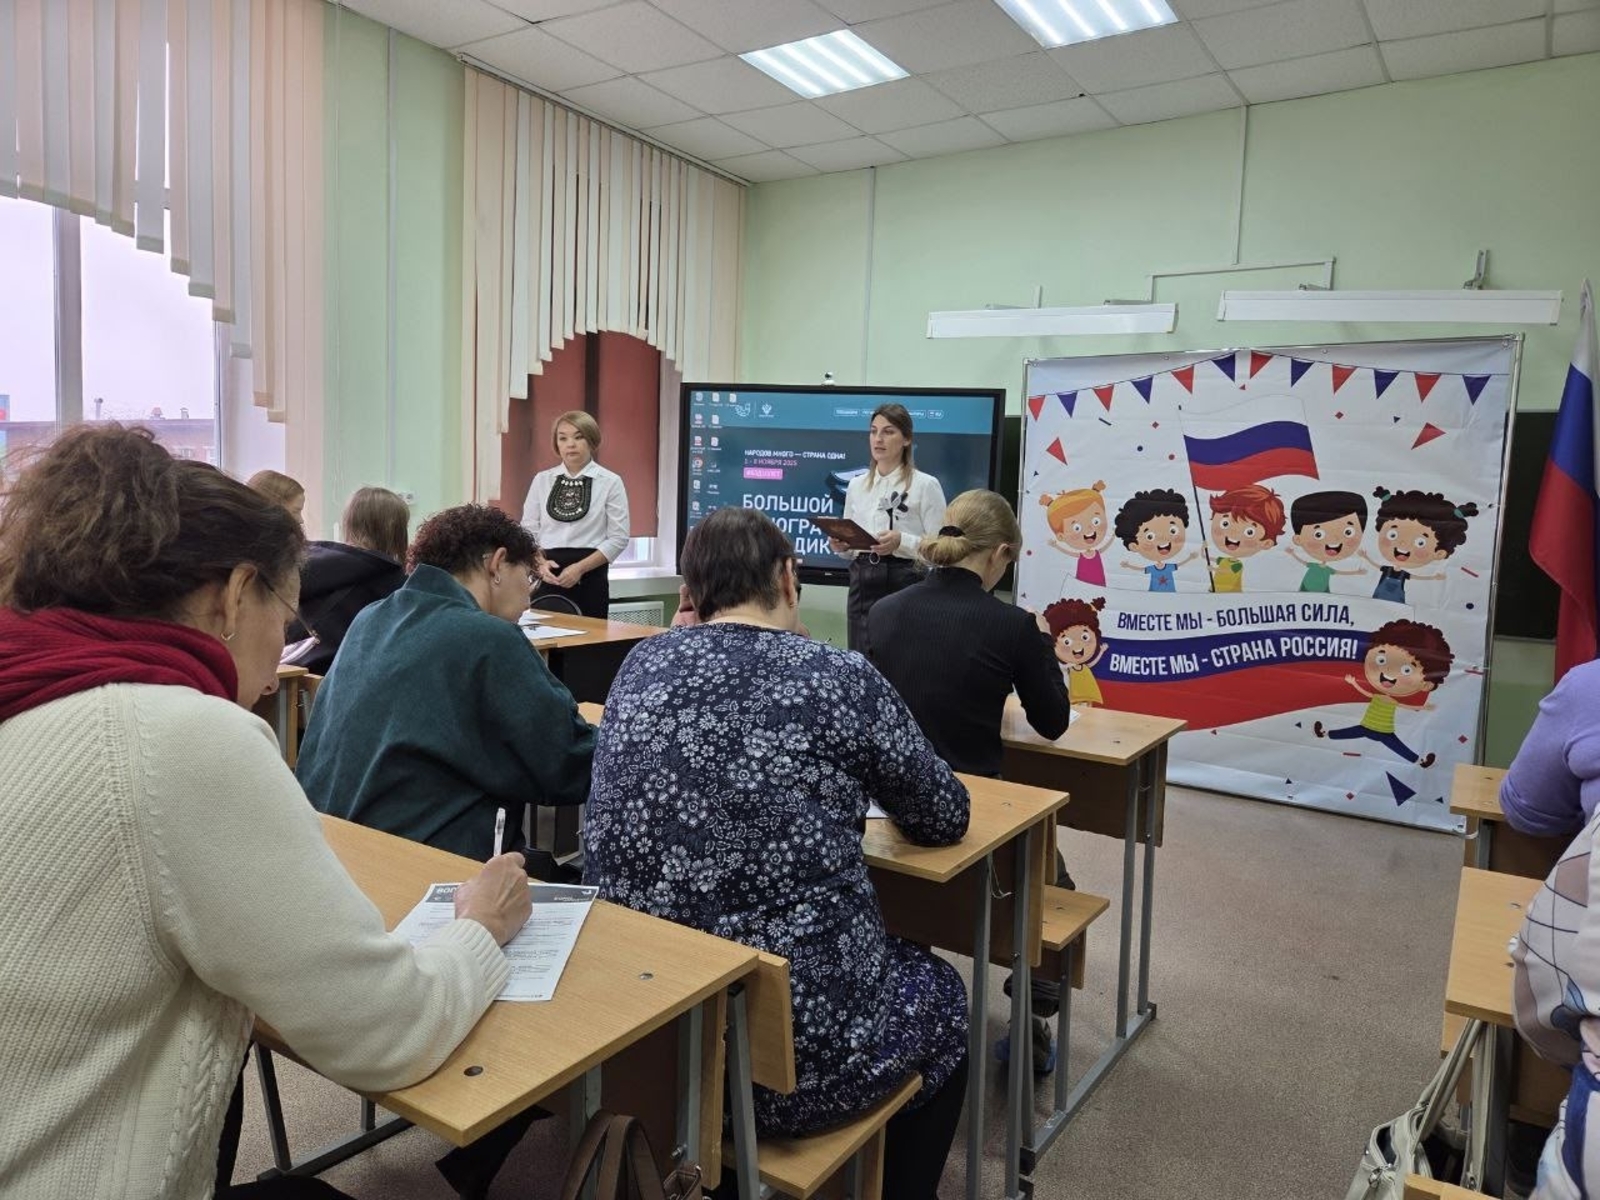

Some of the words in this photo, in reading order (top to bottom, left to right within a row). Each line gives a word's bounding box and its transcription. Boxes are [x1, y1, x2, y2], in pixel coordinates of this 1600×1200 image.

[742, 493, 834, 514] БОЛЬШОЙ
[772, 517, 822, 535] ОГРА
[794, 537, 831, 556] ДИК
[1117, 612, 1172, 631] ВМЕСТЕ
[1176, 612, 1202, 630] МЫ
[1216, 604, 1297, 628] БОЛЬШАЯ
[1301, 603, 1355, 627] СИЛА,
[1109, 653, 1168, 676] ВМЕСТЕ
[1169, 653, 1199, 674] МЫ
[1210, 638, 1277, 667] СТРАНА
[1280, 636, 1358, 659] РОССИЯ!
